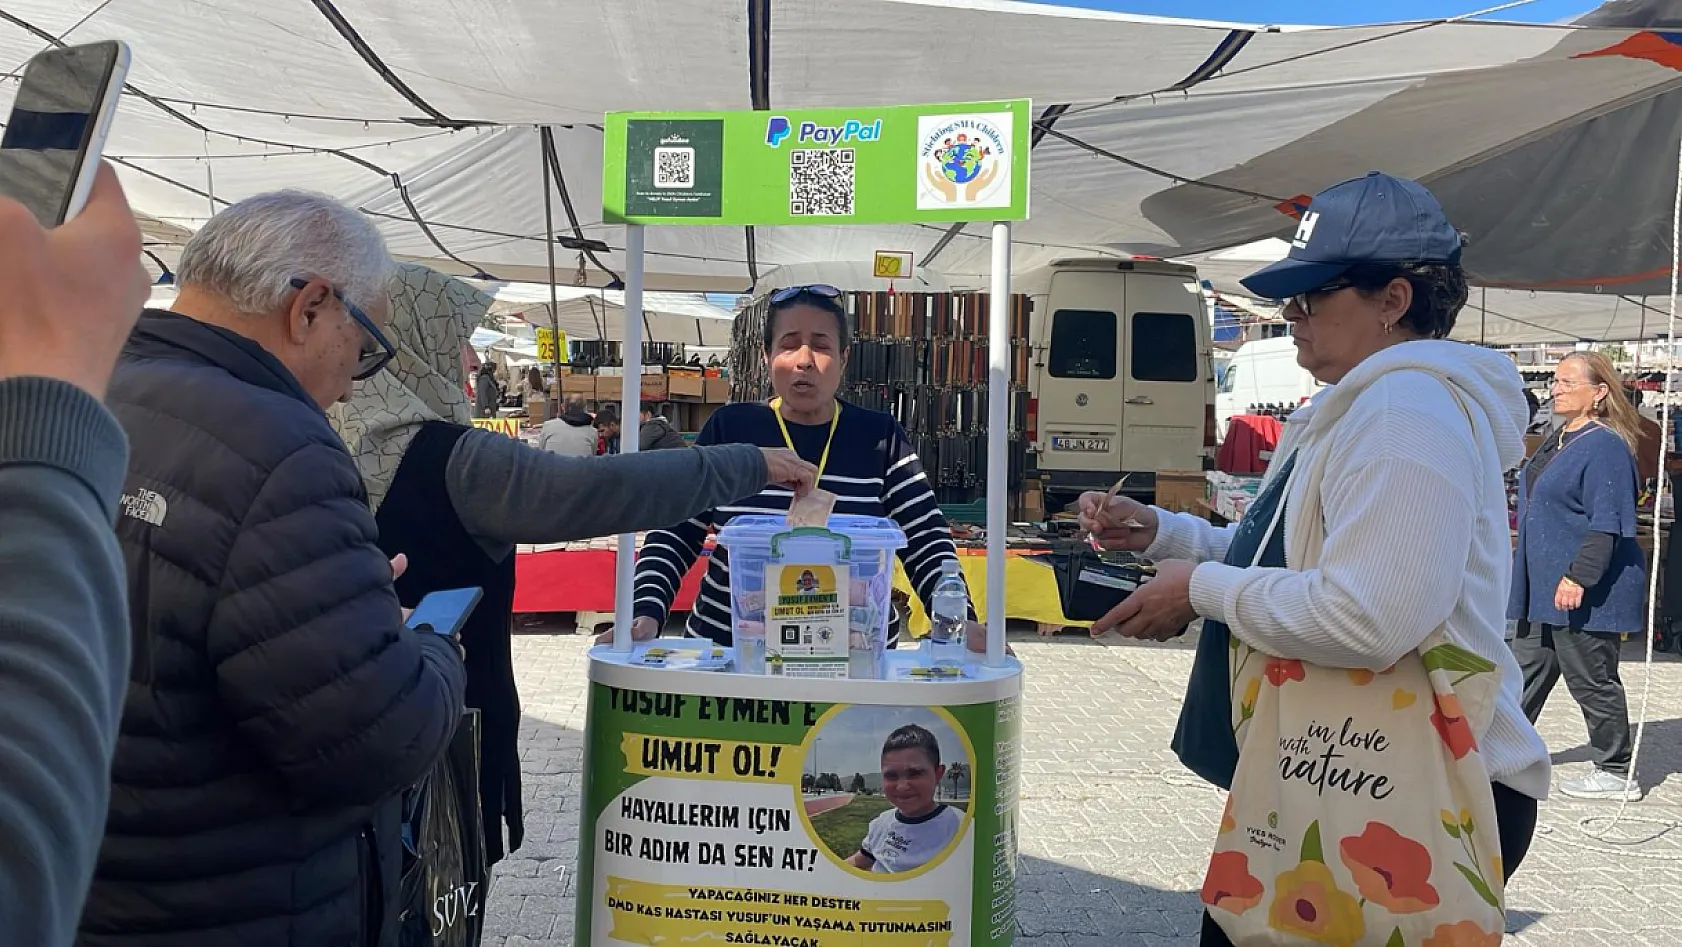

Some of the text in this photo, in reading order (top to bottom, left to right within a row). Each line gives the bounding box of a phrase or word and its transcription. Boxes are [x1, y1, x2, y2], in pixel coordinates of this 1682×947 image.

[799, 119, 881, 145] PayPal
[976, 121, 1005, 155] Children
[1088, 439, 1106, 450] 277
[611, 687, 687, 718] YUSUF
[1279, 736, 1311, 755] with
[1308, 717, 1390, 752] in love
[641, 738, 782, 778] UMUT OL!
[1279, 744, 1394, 800] nature
[639, 837, 690, 864] ADIM
[698, 841, 726, 865] DA
[734, 844, 773, 868] SEN
[781, 847, 819, 873] AT!
[608, 896, 952, 934] DMD KAS HASTASI YUSUF'UN YAŞAMA TUTUNMASINI
[688, 888, 861, 911] YAPACAĞINIZ HER DESTEK
